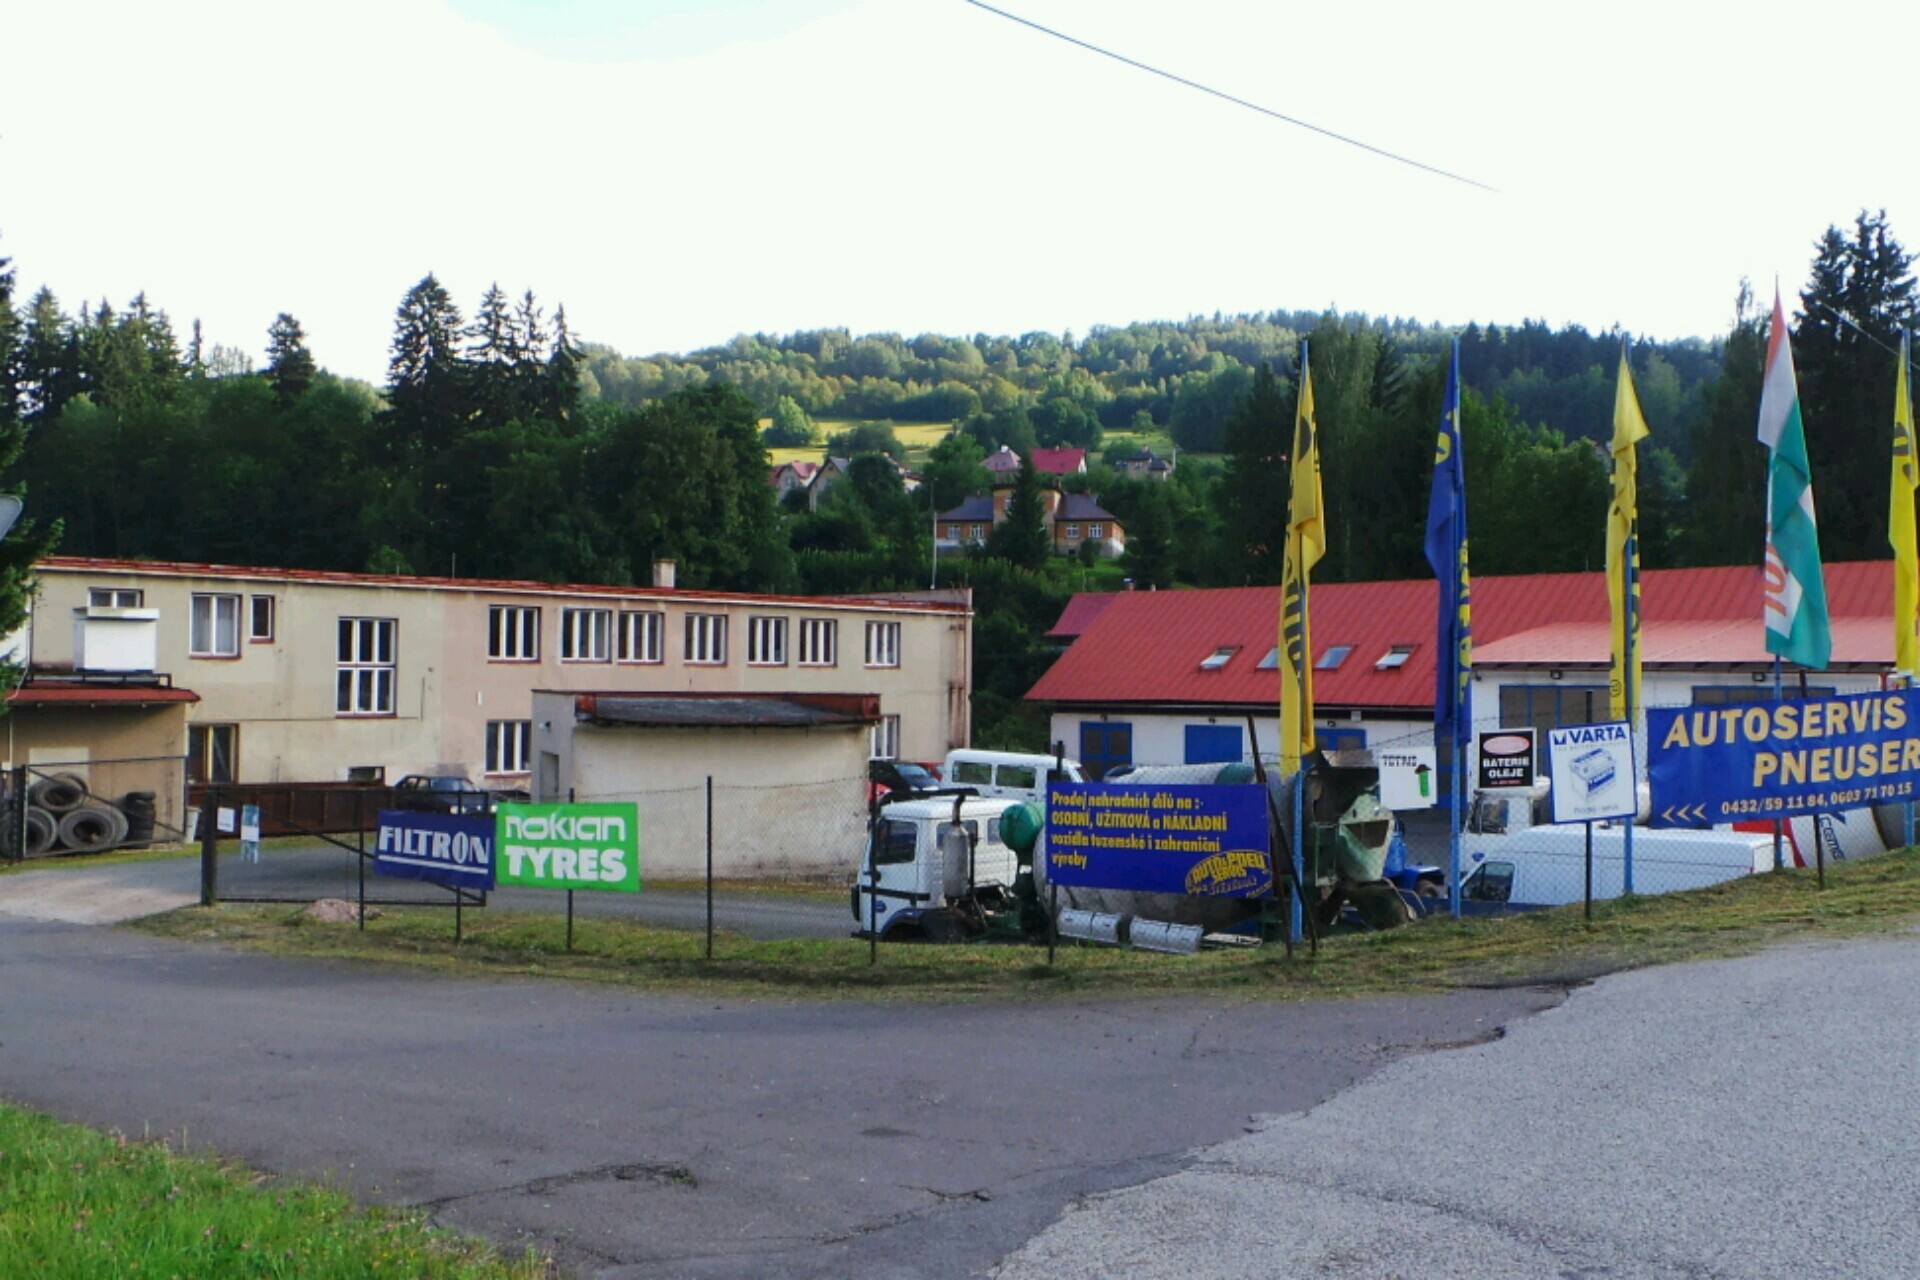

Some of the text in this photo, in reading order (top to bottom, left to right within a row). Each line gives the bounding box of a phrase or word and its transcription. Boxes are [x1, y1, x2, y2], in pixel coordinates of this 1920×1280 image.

[1663, 696, 1907, 750] AUTOSERVIS
[1568, 726, 1626, 744] VARTA
[1483, 756, 1530, 768] BATERIE
[1489, 768, 1524, 779] OLEJE
[1052, 791, 1087, 811] Prodej
[1176, 798, 1193, 809] na
[1153, 819, 1160, 830] a
[378, 825, 490, 864] FILTRON
[1052, 831, 1089, 847] vozidla
[1147, 834, 1153, 850] i
[504, 845, 627, 883] TYRES
